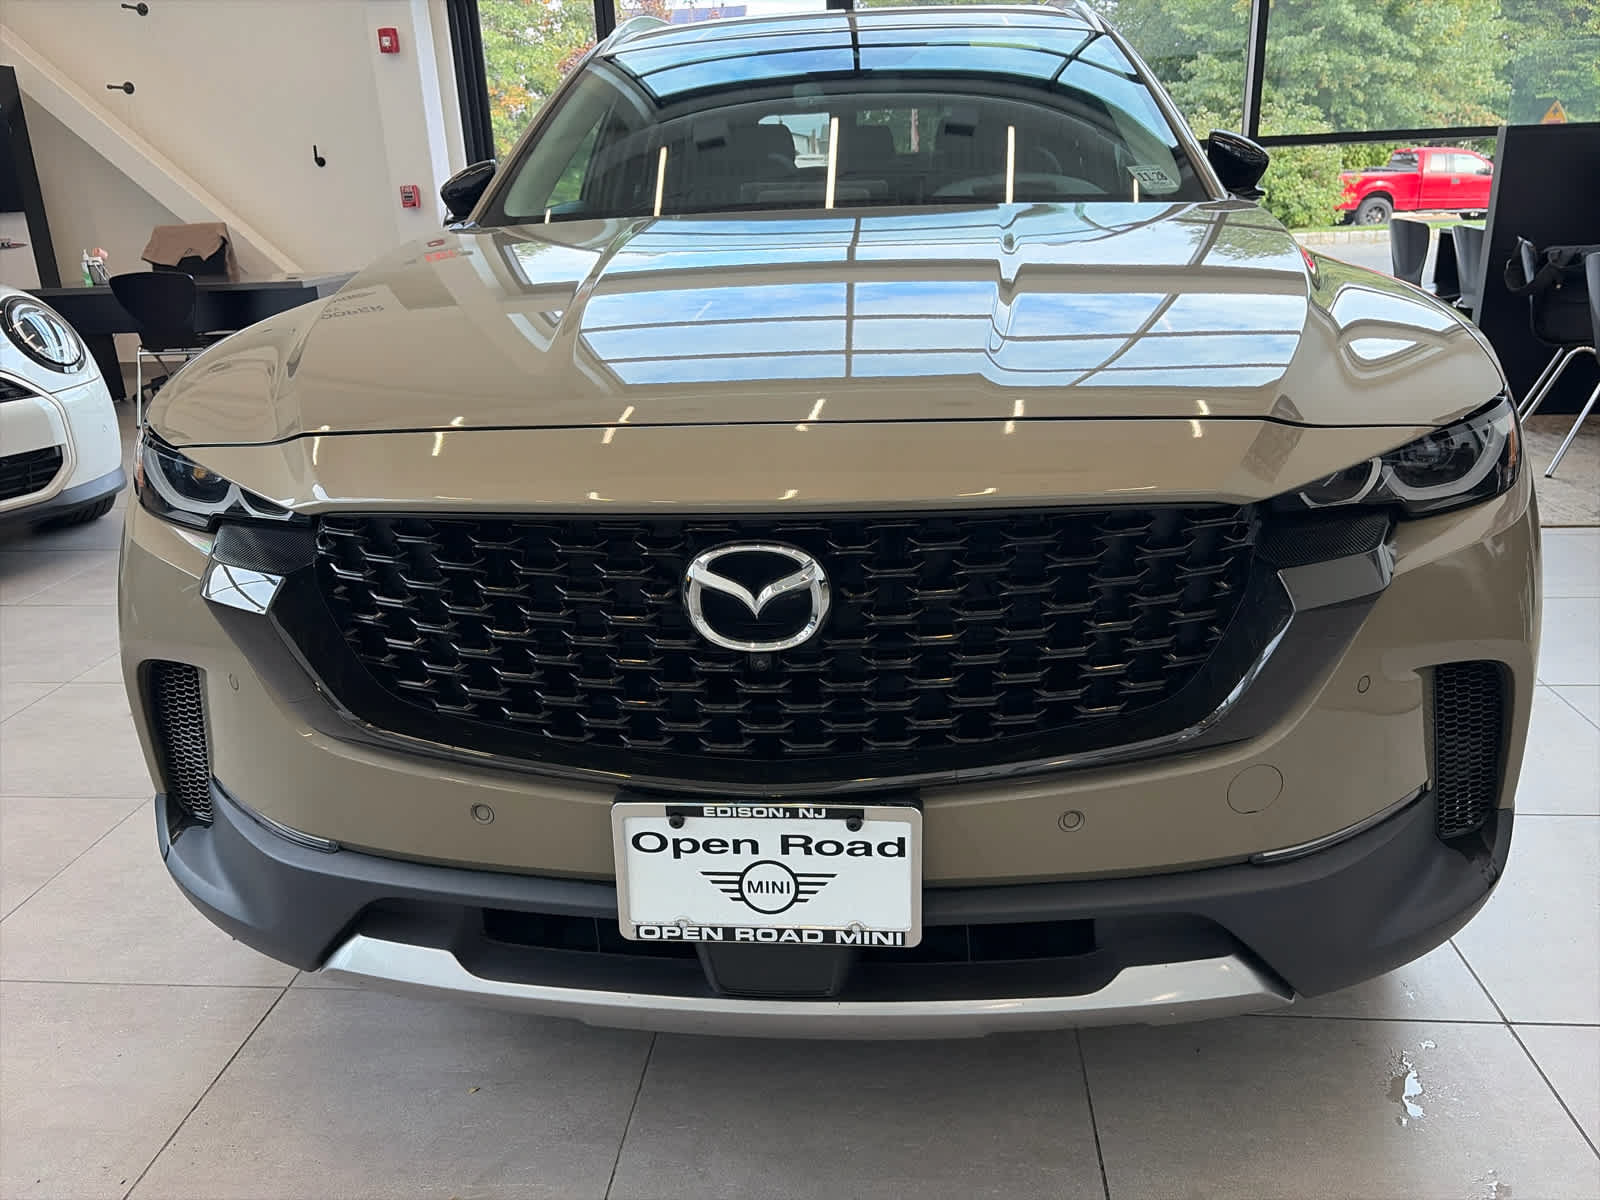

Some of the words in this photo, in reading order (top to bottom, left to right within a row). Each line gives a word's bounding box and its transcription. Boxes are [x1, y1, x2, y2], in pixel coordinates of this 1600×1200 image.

[702, 806, 790, 818] EDISON,
[798, 808, 827, 819] NJ
[631, 831, 760, 859] Open
[780, 834, 906, 858] Road
[747, 880, 791, 895] MINI
[639, 925, 724, 940] OPEN
[735, 928, 824, 943] ROAD
[835, 930, 903, 946] MINI
